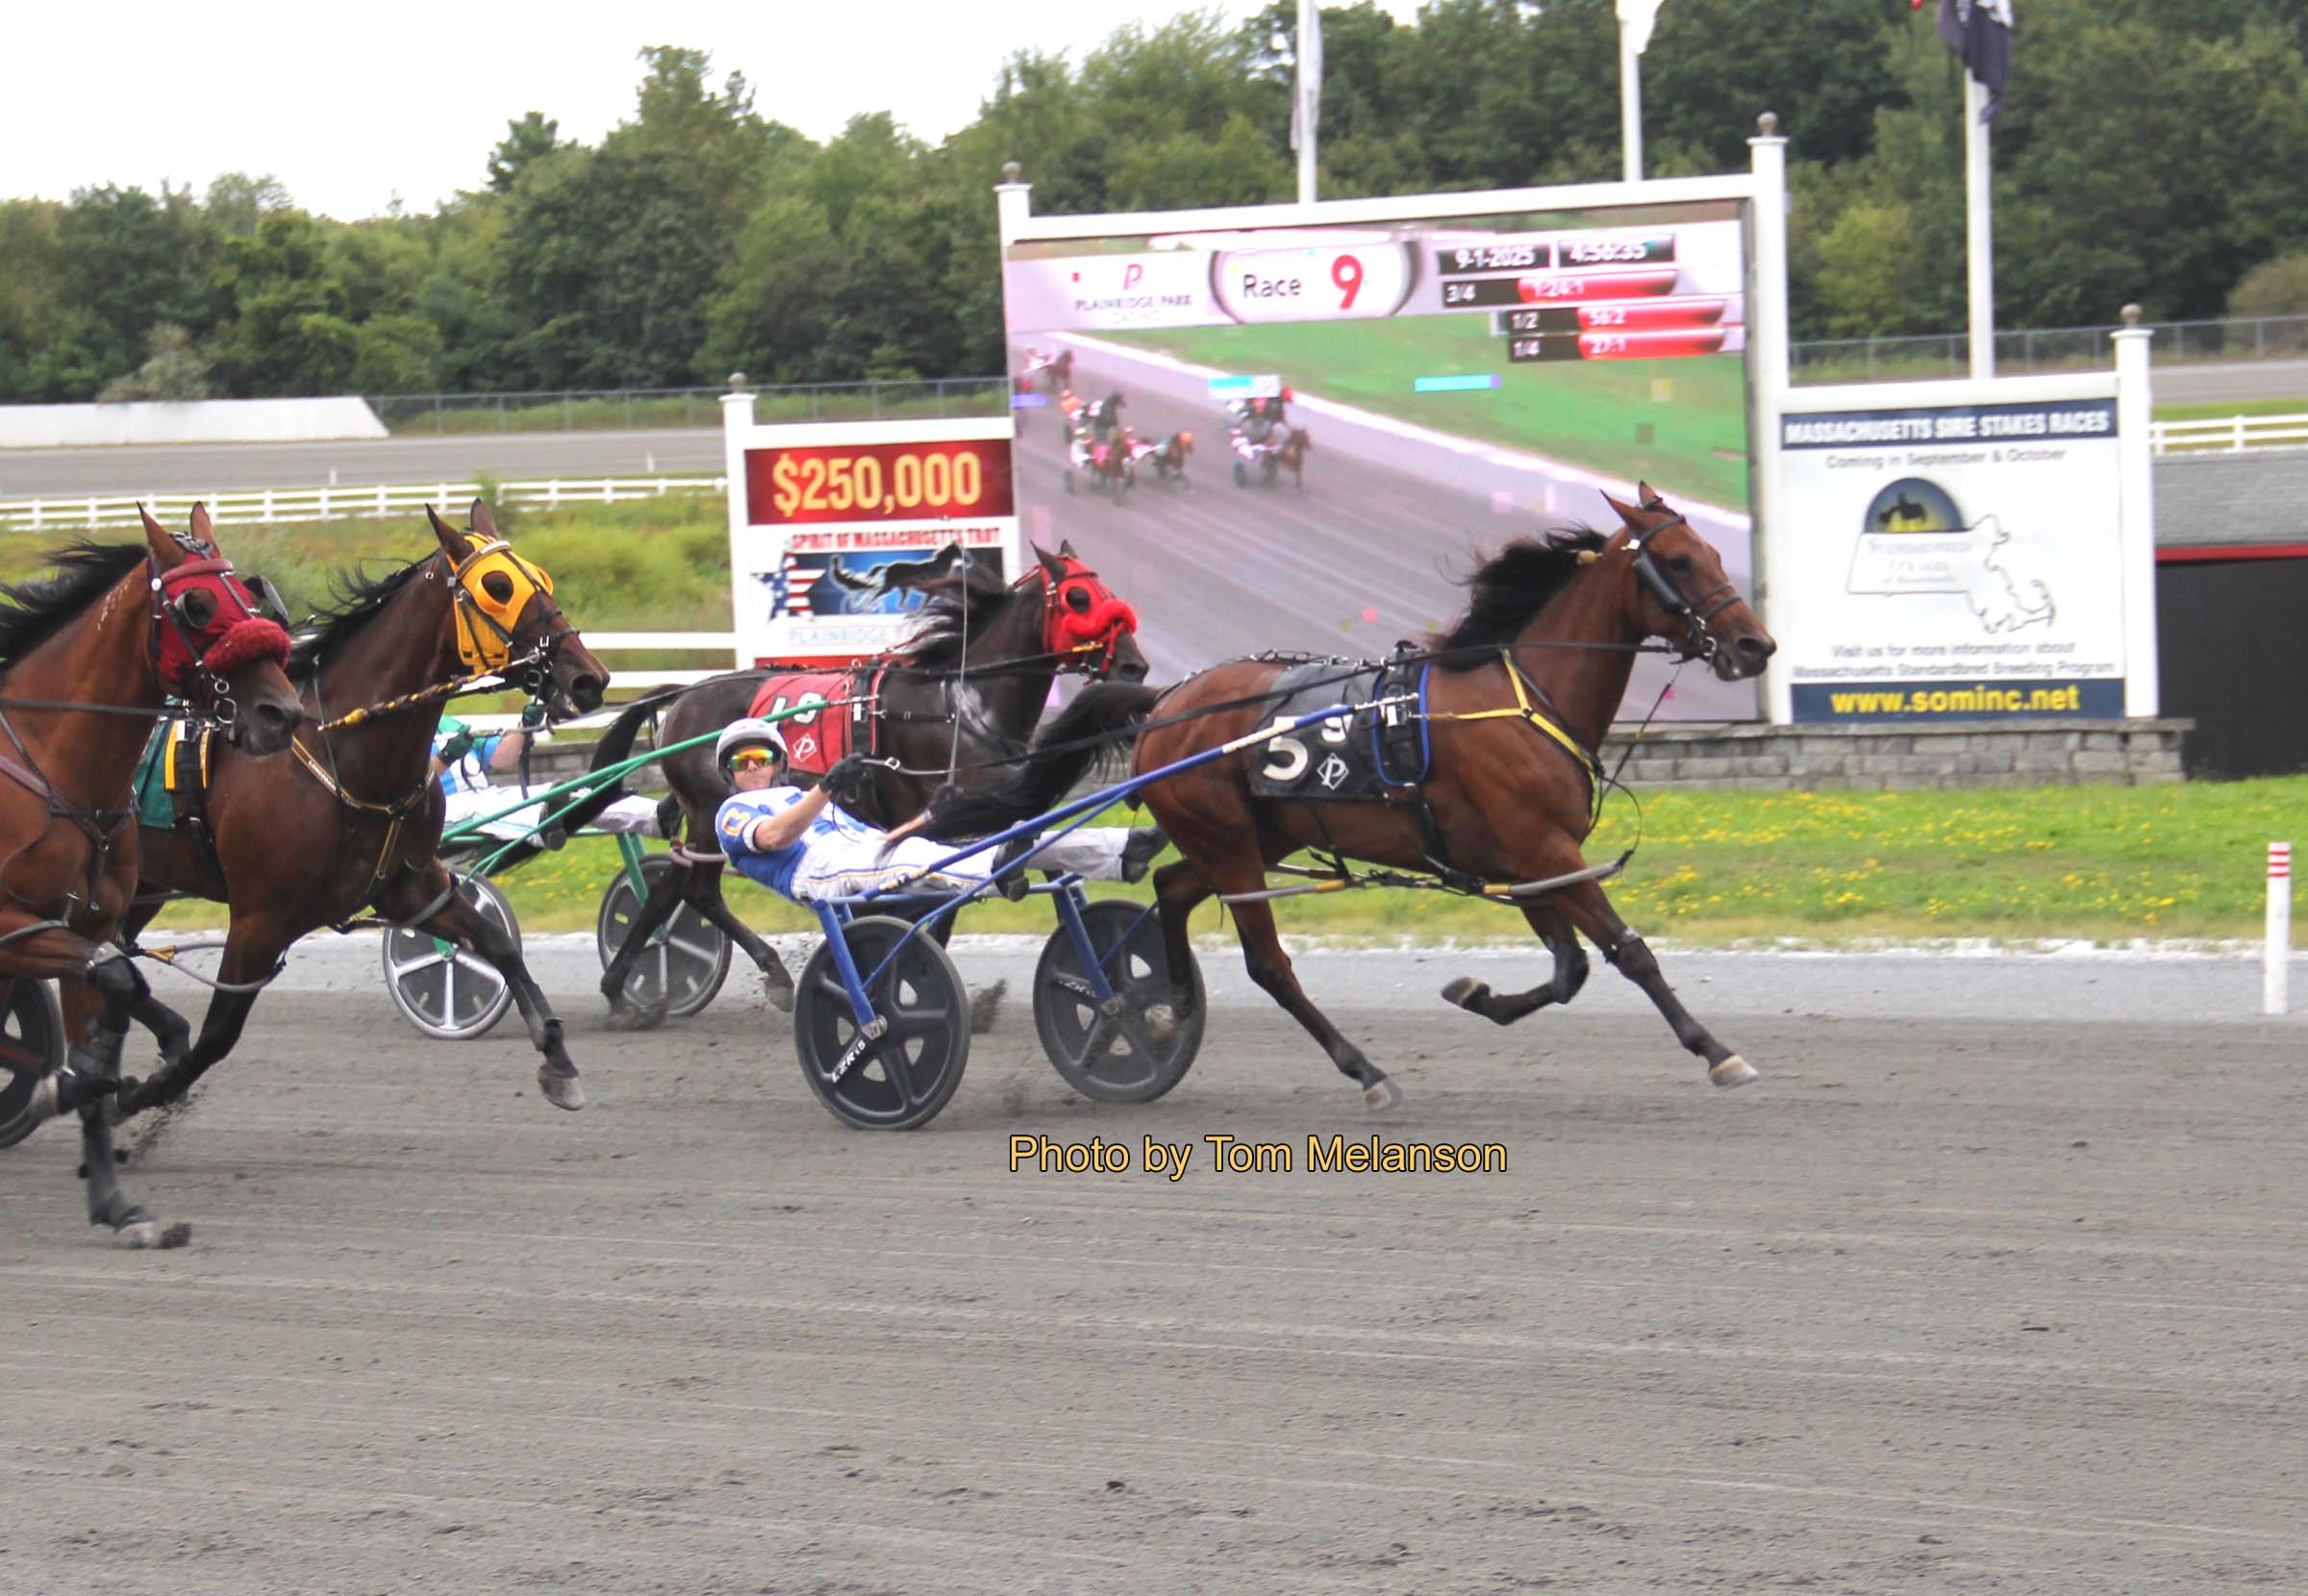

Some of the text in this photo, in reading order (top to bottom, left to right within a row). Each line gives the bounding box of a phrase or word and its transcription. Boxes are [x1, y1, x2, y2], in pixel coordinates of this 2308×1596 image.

[1455, 246, 1536, 269] 9-1-2025
[1242, 274, 1302, 299] Race
[1331, 254, 1364, 310] 9
[1446, 286, 1476, 303] 3/4
[1512, 312, 1538, 330] 1/2
[1514, 340, 1540, 357] 1/4
[1785, 418, 1932, 443] MASSACHUSETTS
[1978, 413, 2046, 436] STAKES
[2048, 411, 2110, 433] RACES
[1826, 455, 1884, 470] Coming
[1889, 454, 1902, 466] in
[1907, 449, 1987, 468] September
[2007, 447, 2067, 462] October
[772, 452, 981, 517] $250,000
[1832, 644, 1863, 658] Visit
[1887, 645, 1906, 657] for
[1911, 645, 1946, 657] more
[1951, 641, 2029, 656] information
[2036, 641, 2075, 655] about
[1831, 685, 2080, 712] www.sominc.net
[1262, 716, 1309, 781] 5
